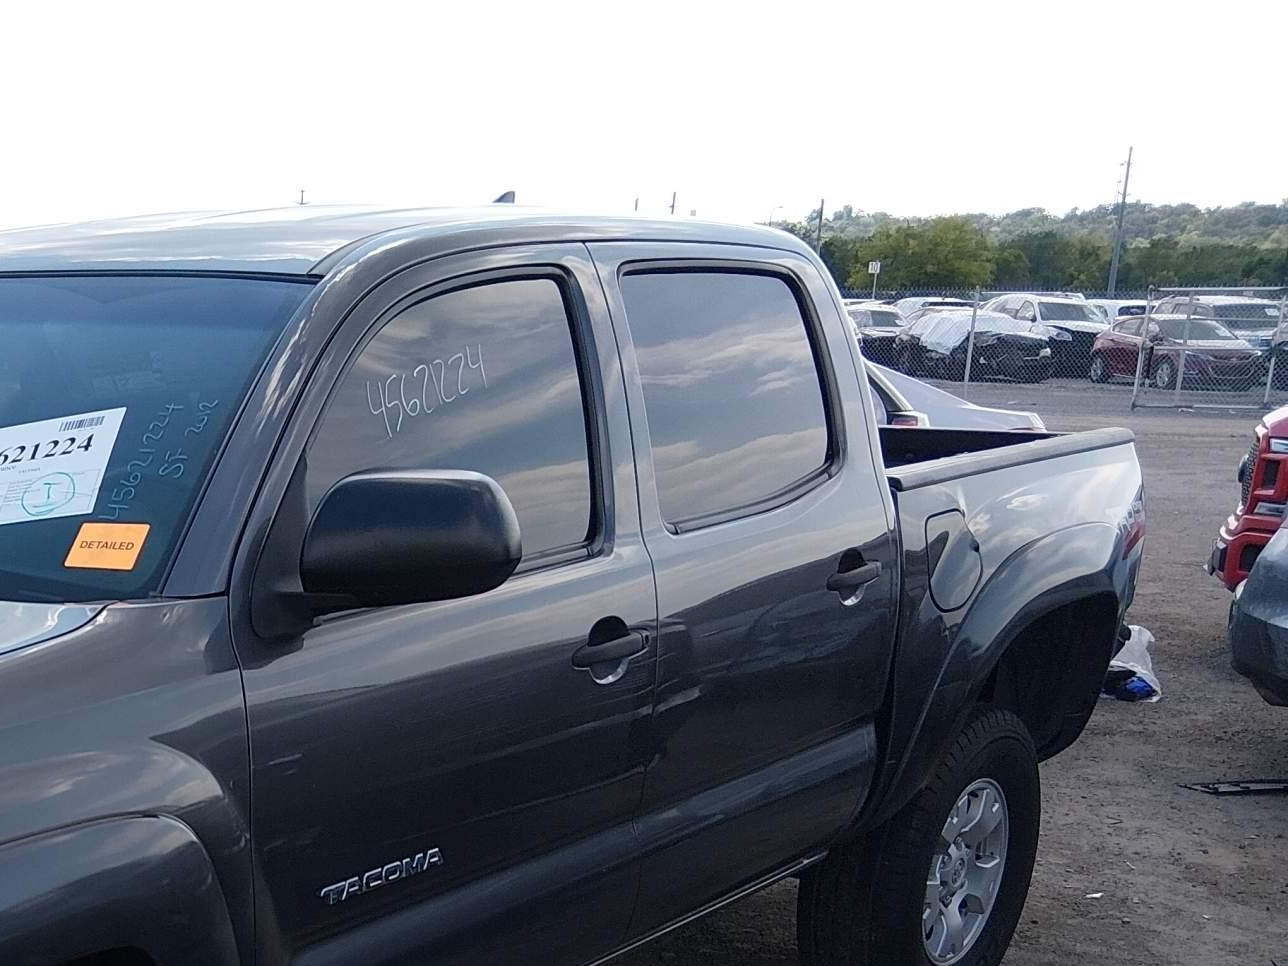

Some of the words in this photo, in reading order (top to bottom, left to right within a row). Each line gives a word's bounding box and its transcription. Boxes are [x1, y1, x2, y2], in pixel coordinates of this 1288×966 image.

[97, 403, 185, 520] 45621224
[79, 541, 135, 551] DETAILED
[320, 847, 444, 905] TACOMA
